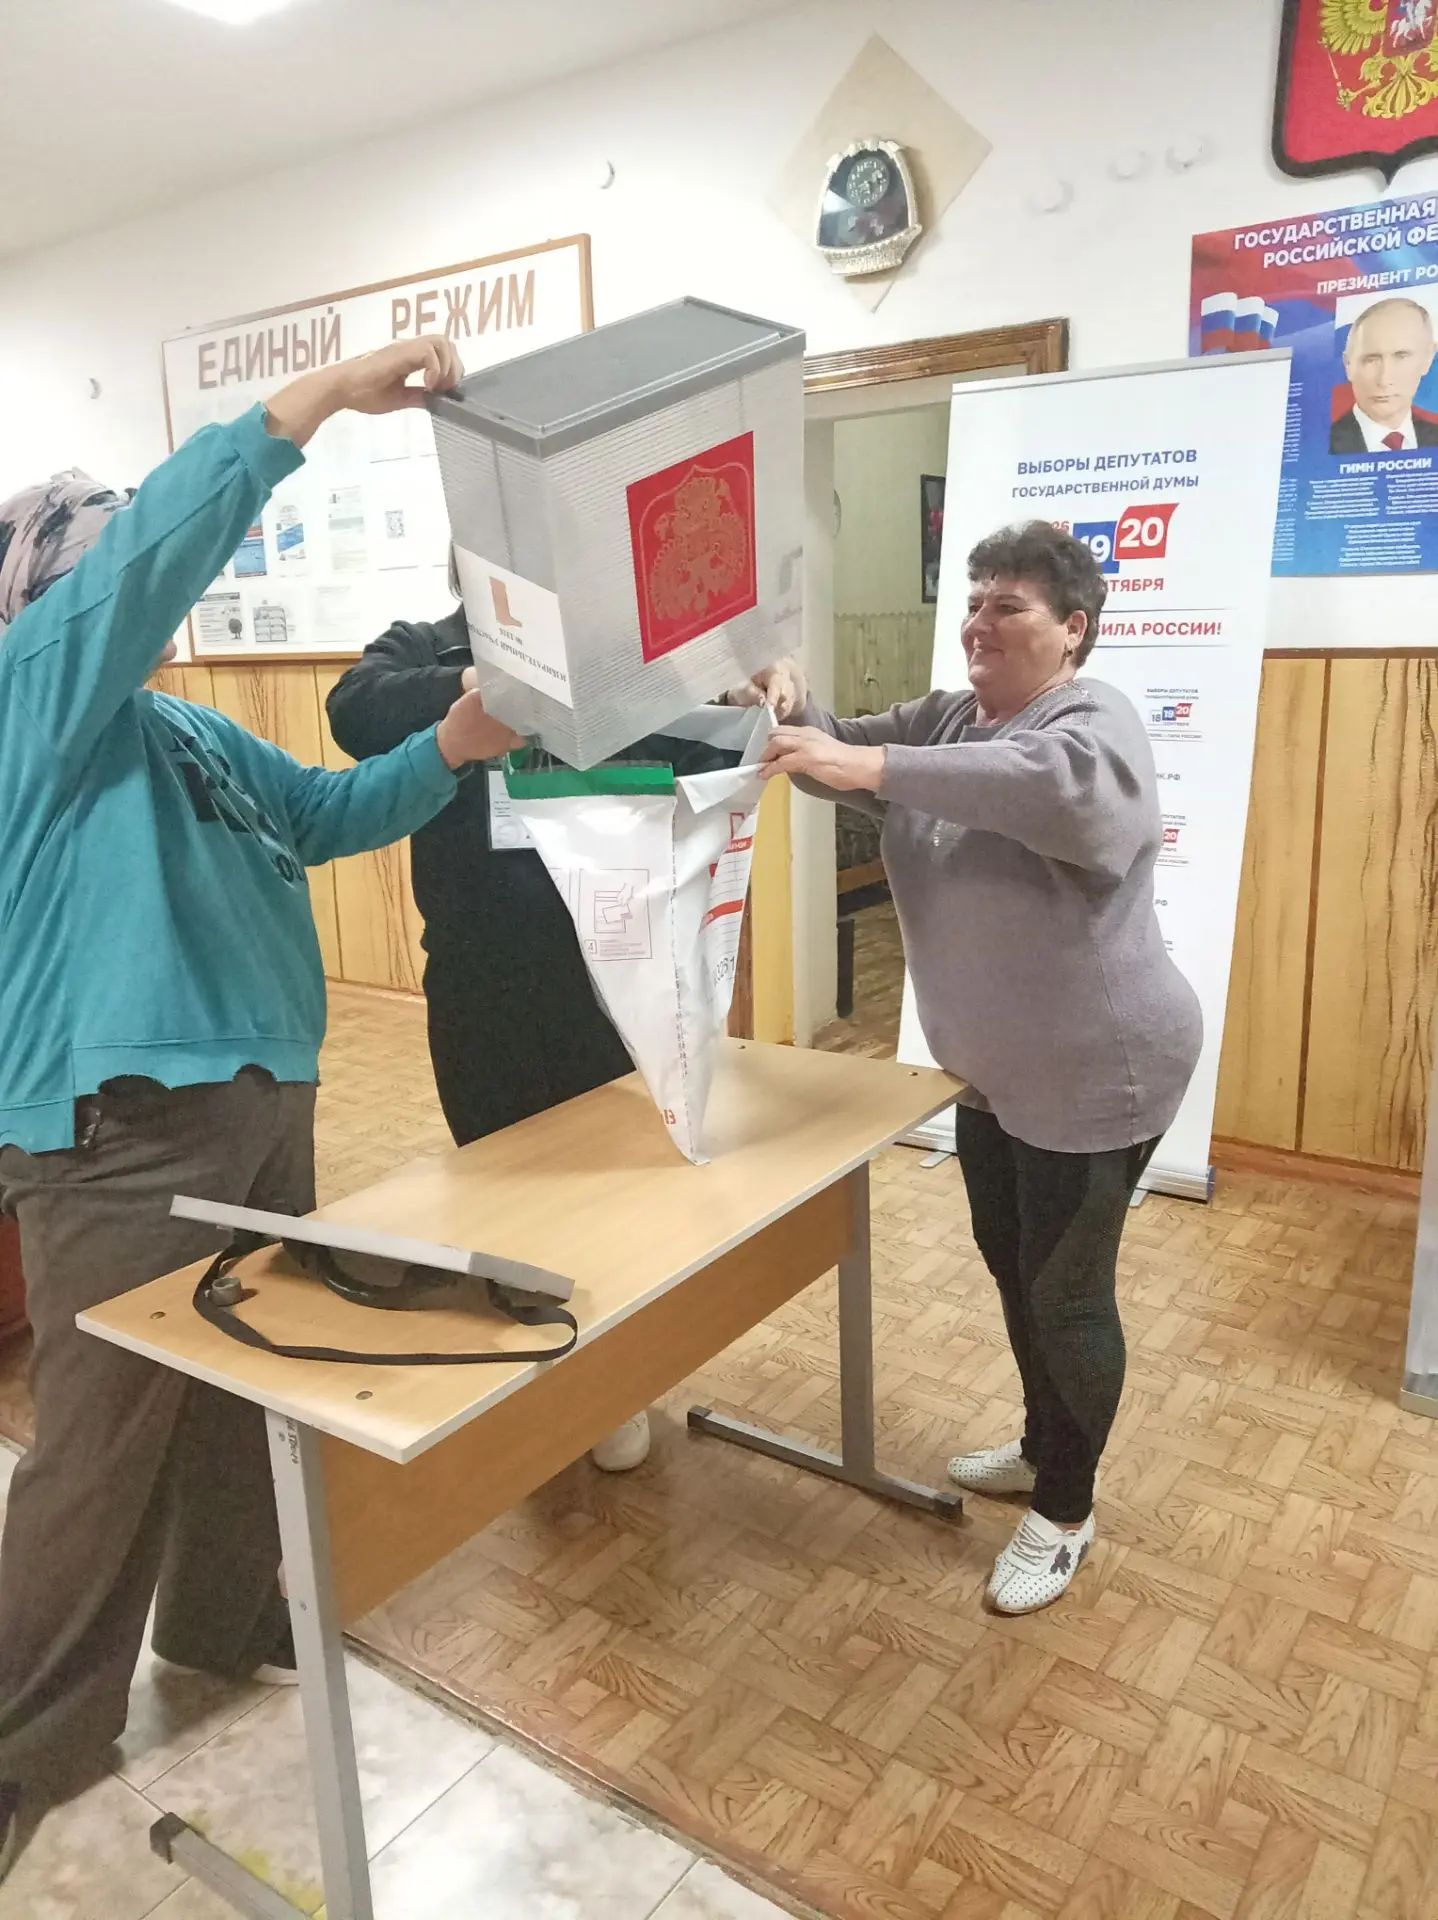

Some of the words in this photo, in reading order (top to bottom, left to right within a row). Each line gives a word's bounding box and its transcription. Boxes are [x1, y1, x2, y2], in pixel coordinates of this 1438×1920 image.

[1234, 198, 1436, 250] ГОСУДАРСТВЕННАЯ
[1263, 227, 1400, 268] РОССИЙСКОЙ
[1407, 224, 1438, 246] ФЕ
[1317, 269, 1411, 294] ПРЕЗИДЕНТ
[1415, 264, 1438, 280] РО
[198, 306, 341, 389] ЕДИНЫЙ
[391, 269, 535, 340] РЕЖИМ
[1017, 457, 1090, 475] ВЫБОРЫ
[1094, 449, 1197, 472] ДЕПУТАТОВ
[1340, 462, 1374, 474] ГИМН
[1377, 458, 1432, 471] РОССИИ
[1012, 476, 1150, 498] ГОСУДАРСТВЕННОЙ
[1153, 475, 1199, 490] ДУМЫ
[1119, 516, 1164, 548] 20
[1106, 578, 1164, 592] ТЯБРЯ
[1098, 623, 1136, 636] ИЛА
[1141, 622, 1221, 636] РОССИИ!
[1176, 705, 1189, 715] 20
